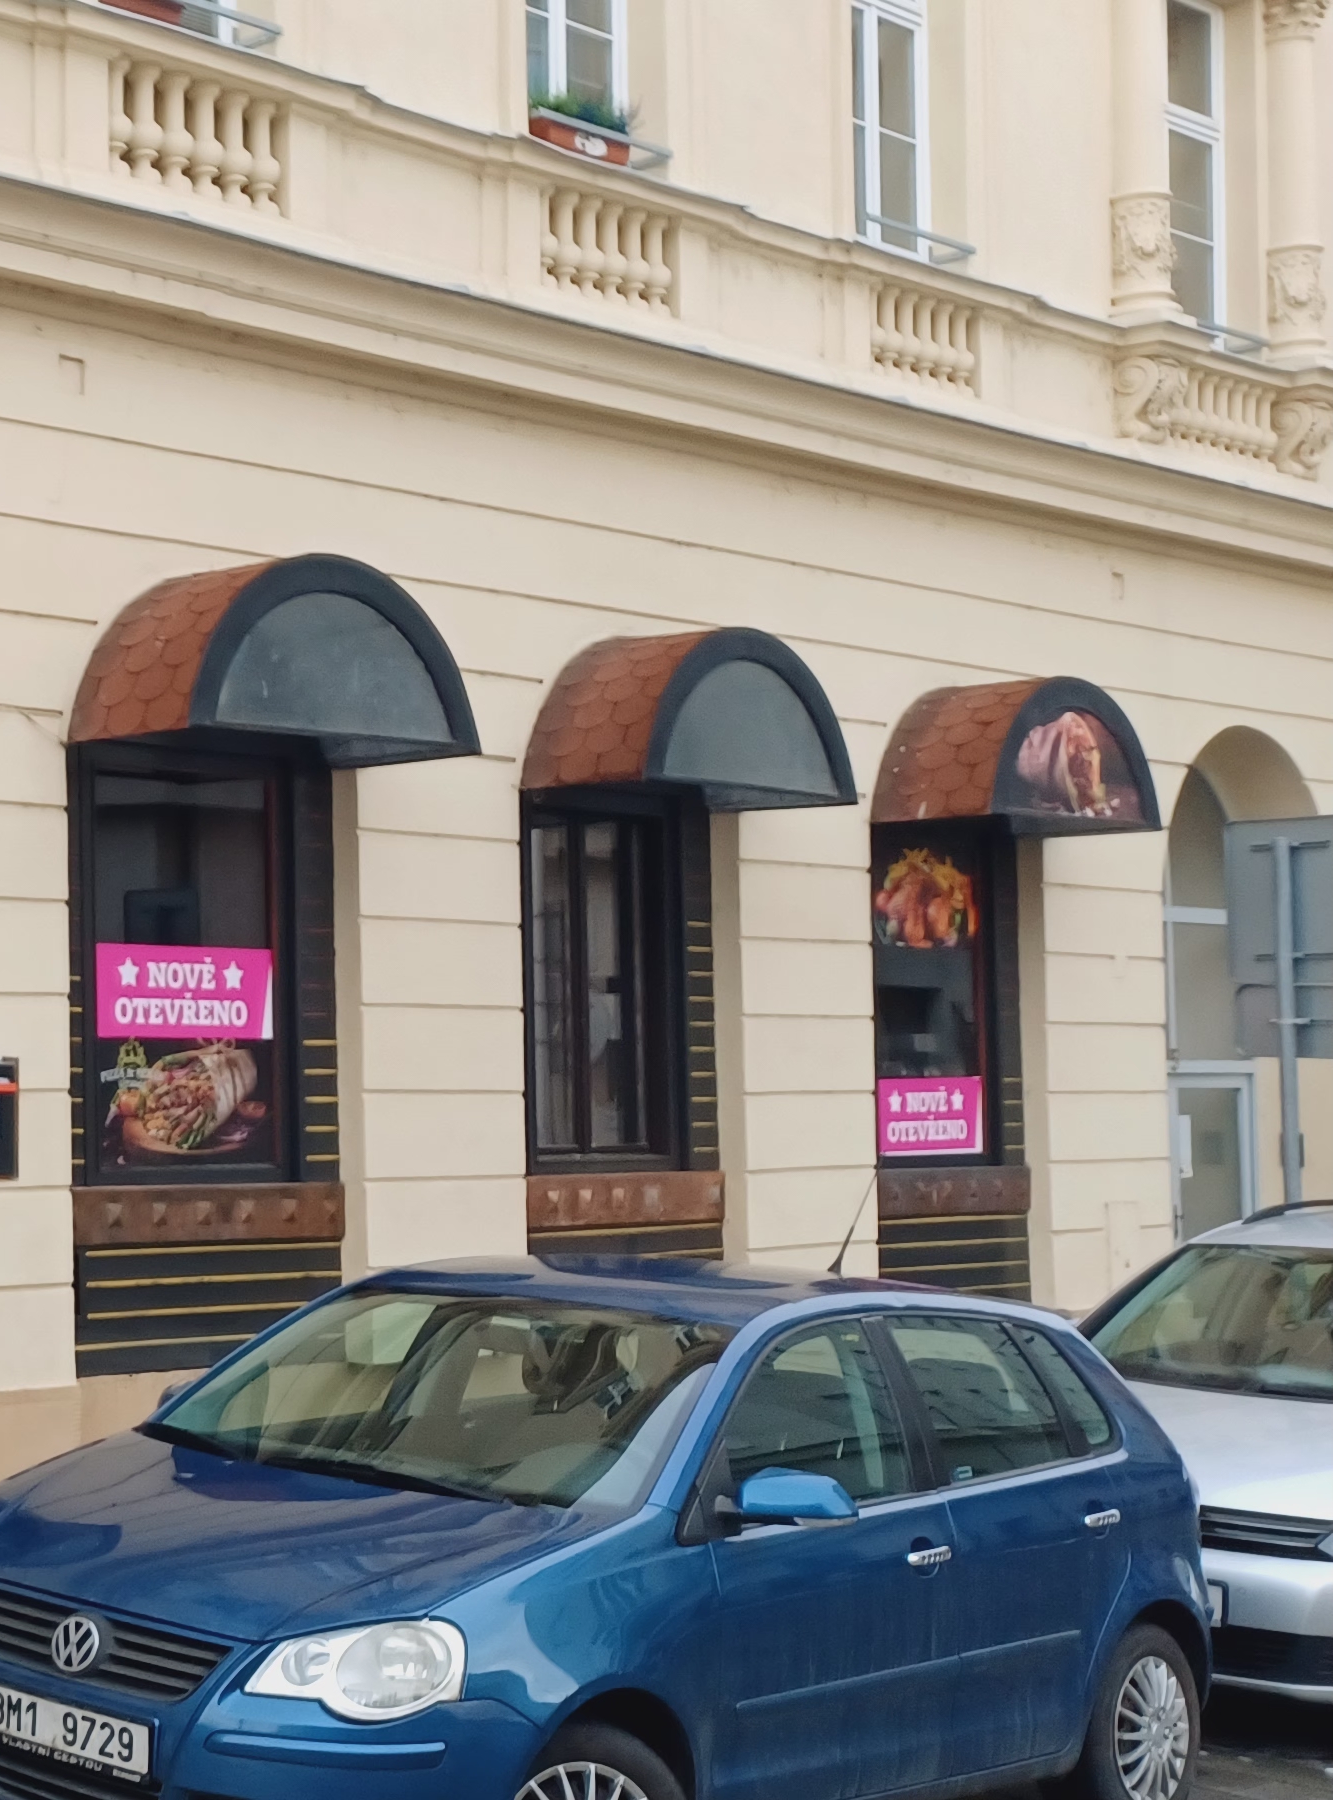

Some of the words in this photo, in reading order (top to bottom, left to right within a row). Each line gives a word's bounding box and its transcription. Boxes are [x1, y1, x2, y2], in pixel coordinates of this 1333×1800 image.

[146, 956, 217, 990] NOVĚ
[114, 992, 249, 1027] OTEVŘENO
[905, 1085, 949, 1114] NOVĚ
[62, 1711, 134, 1763] 9729
